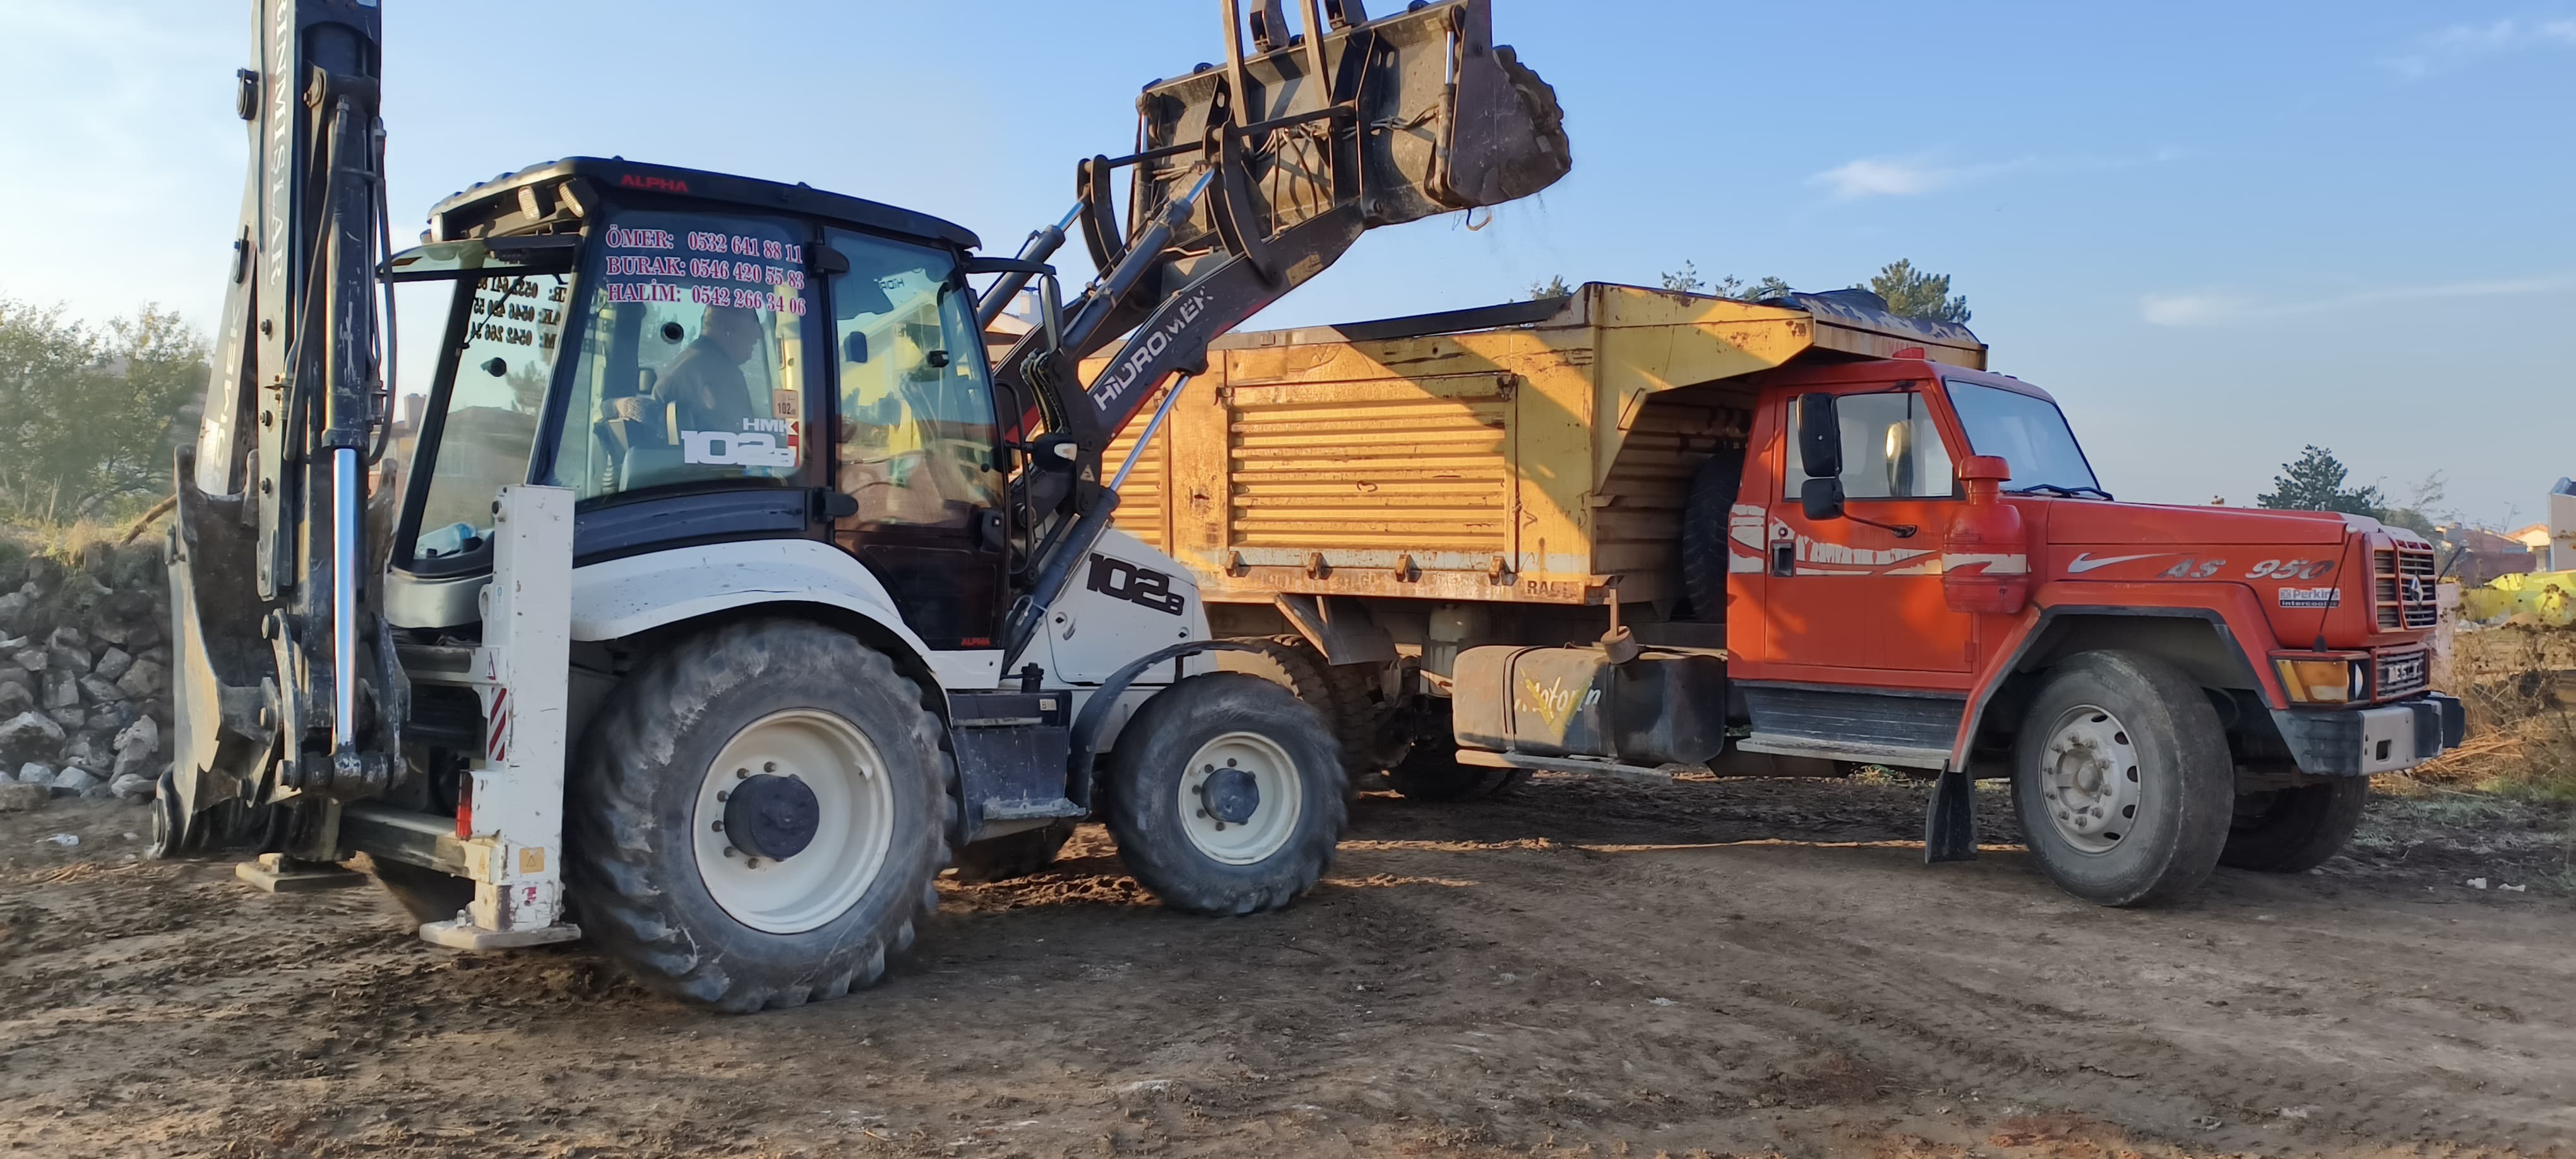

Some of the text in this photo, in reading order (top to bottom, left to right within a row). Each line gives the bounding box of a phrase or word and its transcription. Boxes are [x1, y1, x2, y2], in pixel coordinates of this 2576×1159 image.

[621, 174, 688, 192] ALPHA
[605, 224, 802, 264] ÖMER: 0532 641 88 11
[605, 256, 805, 290] BURAK: 0546 420 55 83
[607, 278, 806, 316] HALİM: 0542 266 34 06
[742, 417, 798, 436] HMK
[2245, 559, 2335, 580] 950
[1087, 553, 1184, 616] 102B
[2293, 589, 2339, 598] Perkins
